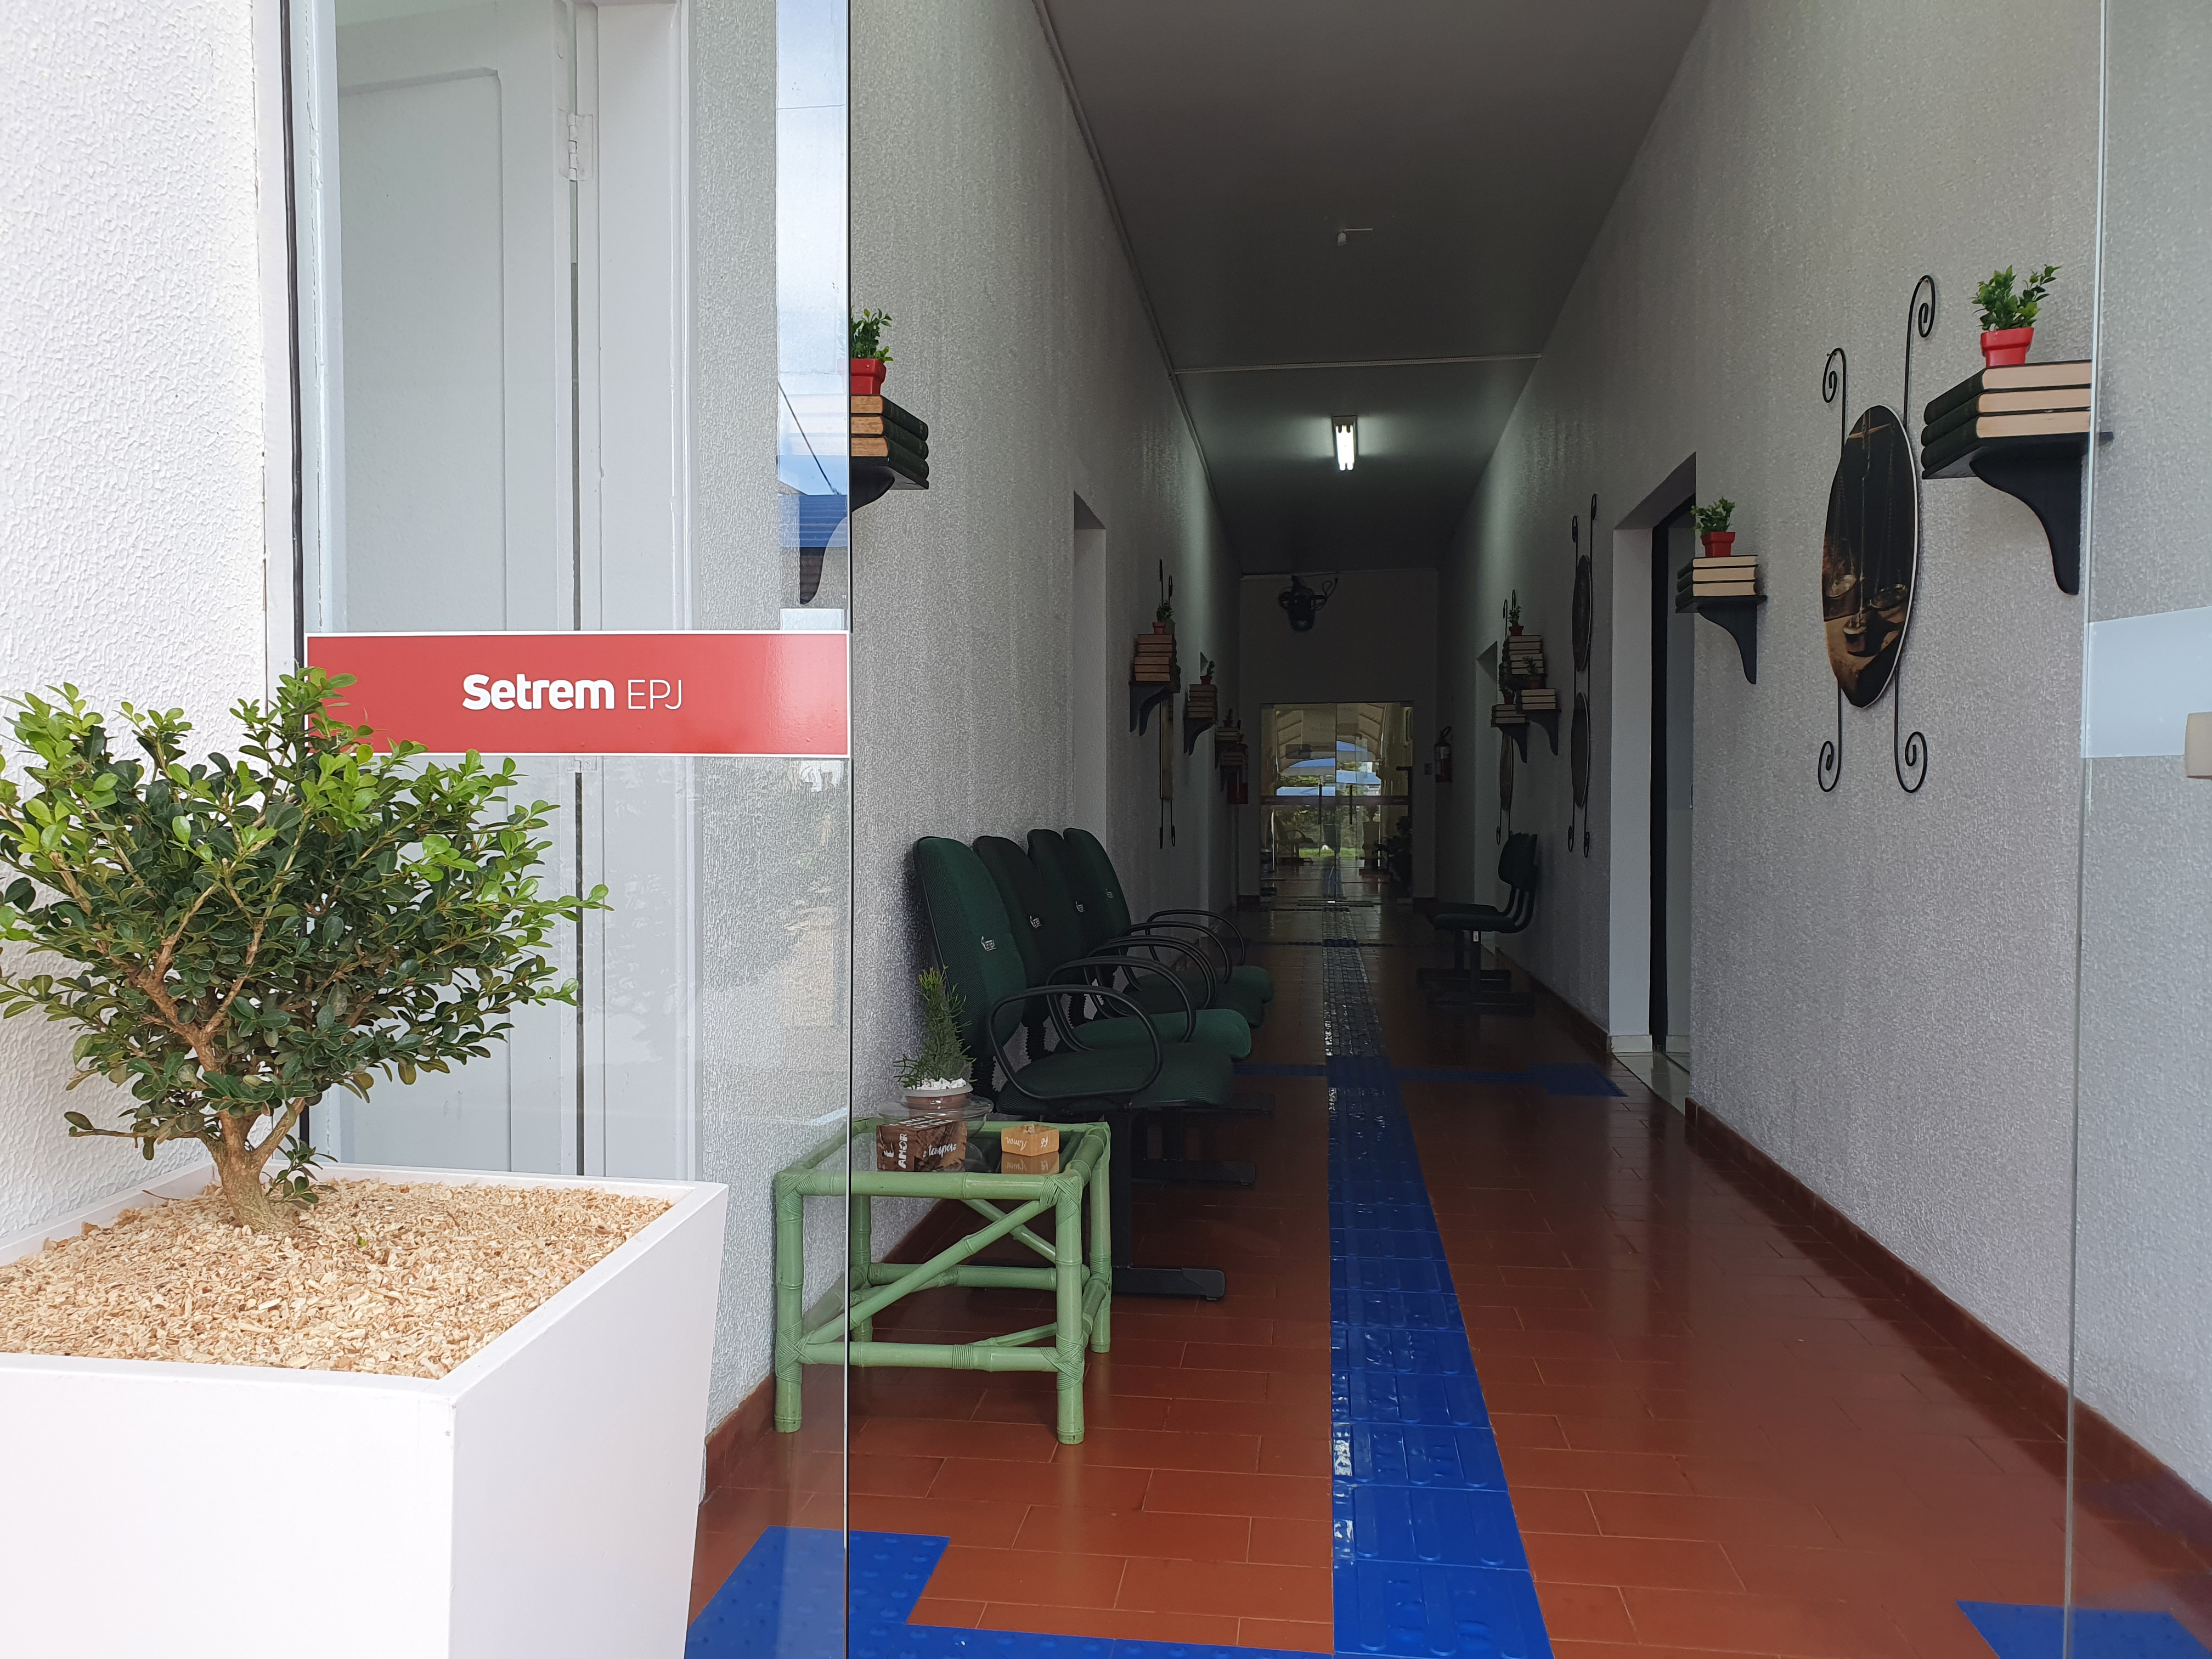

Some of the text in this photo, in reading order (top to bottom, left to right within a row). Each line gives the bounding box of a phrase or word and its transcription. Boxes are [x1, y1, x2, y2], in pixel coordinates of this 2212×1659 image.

[462, 674, 681, 710] Setrem EPJ
[898, 1133, 908, 1169] AMOR
[928, 1143, 957, 1158] tempero
